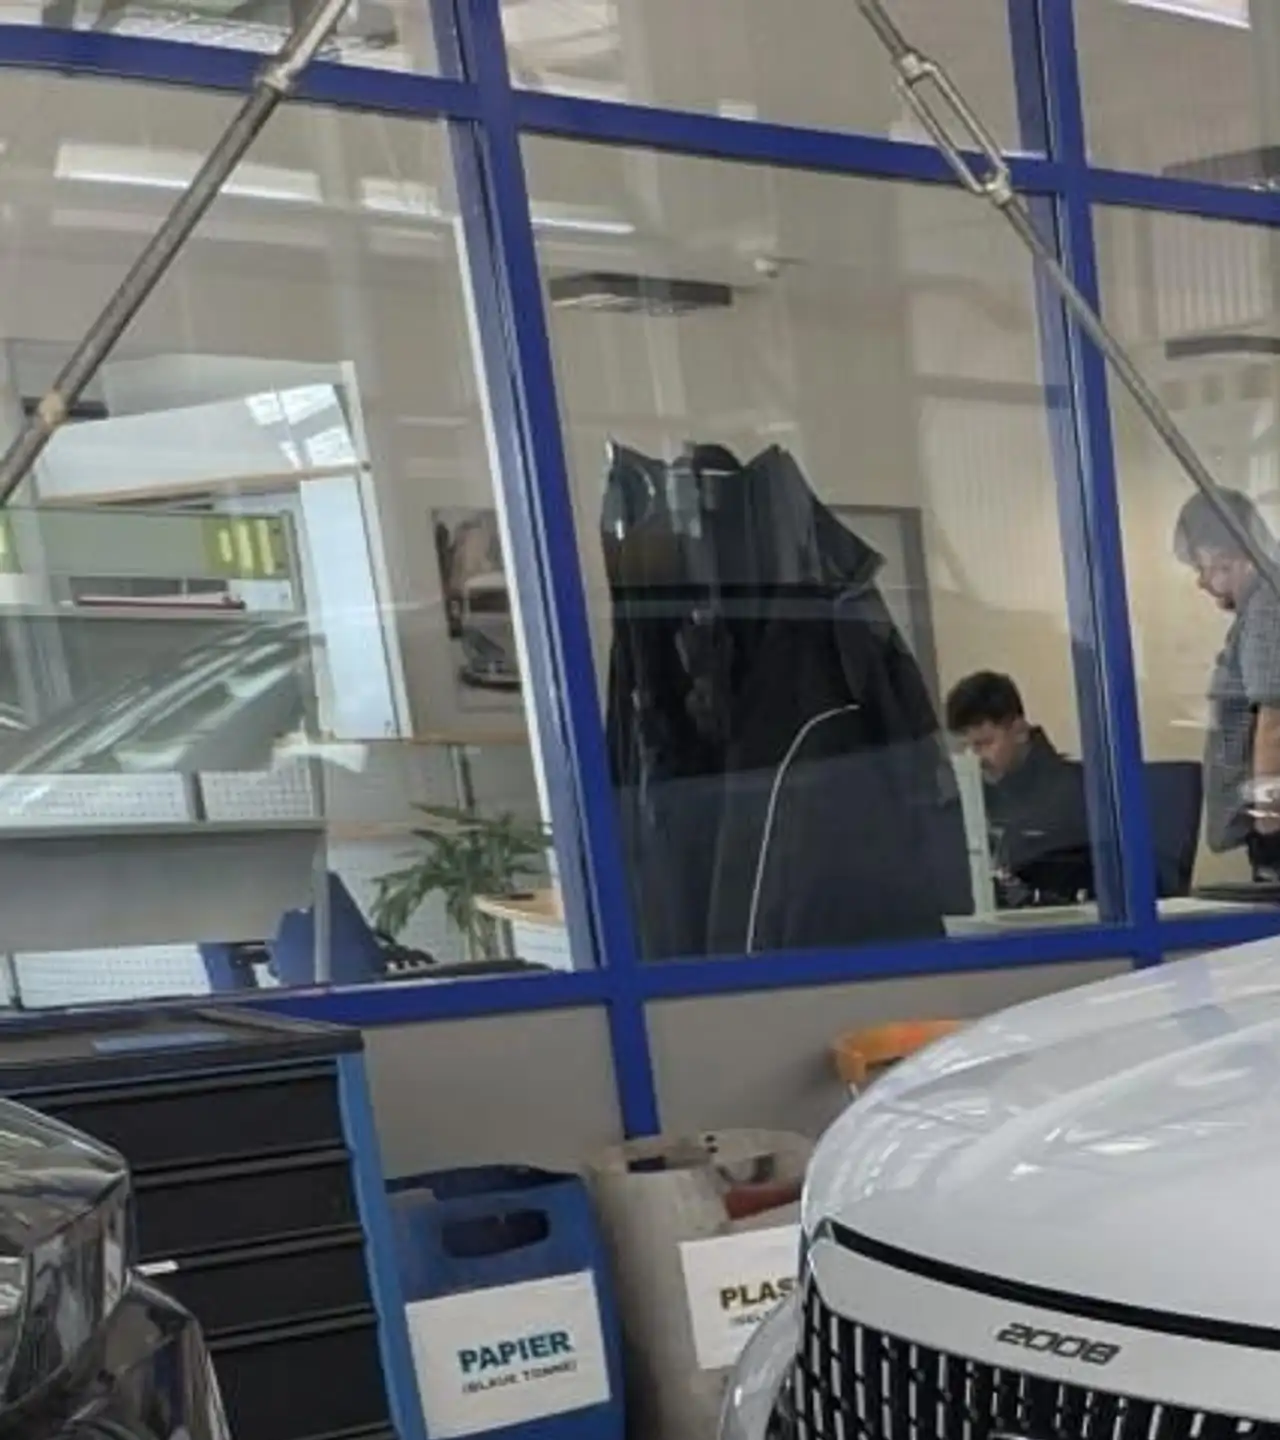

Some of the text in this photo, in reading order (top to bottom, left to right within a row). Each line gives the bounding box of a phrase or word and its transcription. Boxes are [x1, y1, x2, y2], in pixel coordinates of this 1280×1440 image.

[720, 1277, 796, 1311] PLAS
[458, 1330, 574, 1373] PAPIER
[997, 1322, 1121, 1365] 2008
